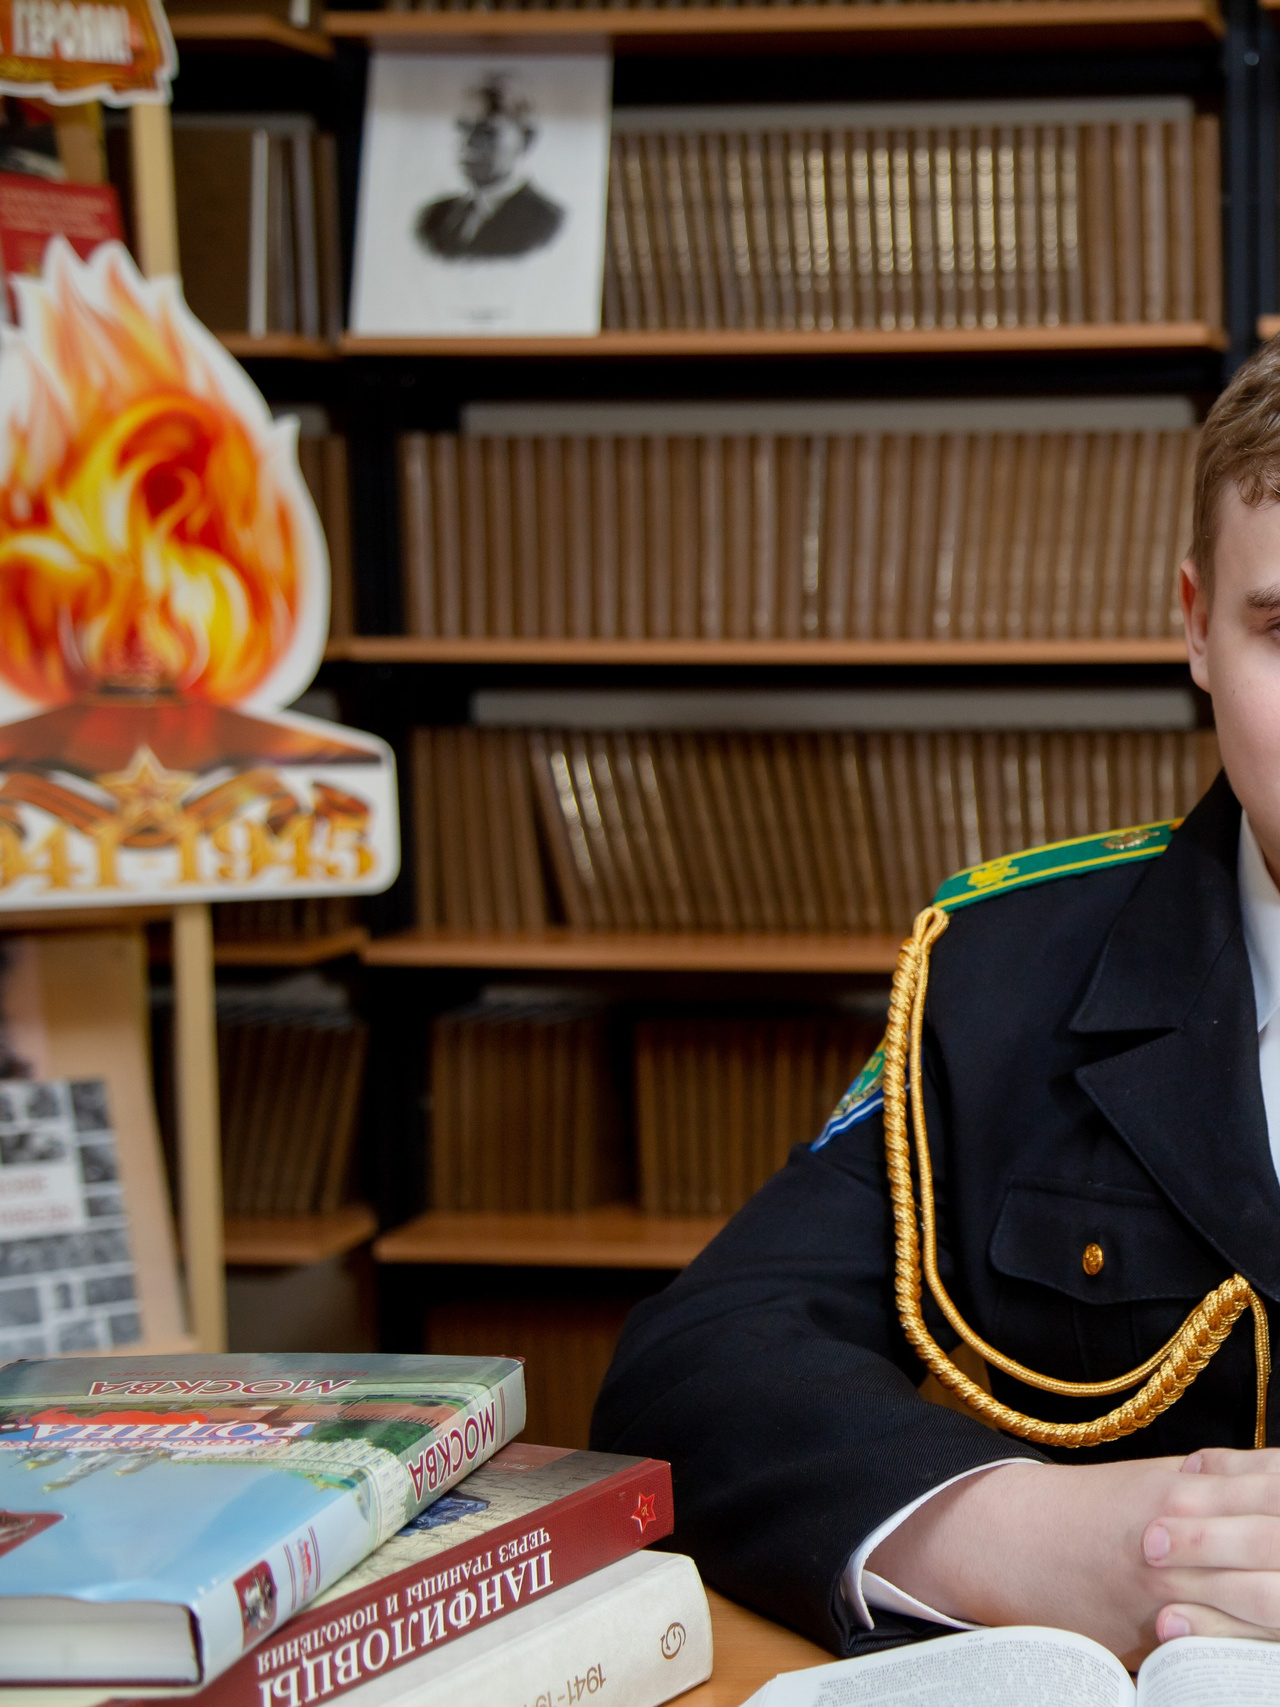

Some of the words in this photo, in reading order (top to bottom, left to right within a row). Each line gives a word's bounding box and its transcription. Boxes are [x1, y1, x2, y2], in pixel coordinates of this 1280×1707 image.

[89, 1379, 356, 1396] МОСКВА
[406, 1399, 495, 1504] МОСКВА
[498, 1527, 551, 1562] ЧЕРЕЗ
[406, 1551, 493, 1599] ГРАНИЦЫ
[258, 1550, 554, 1707] ПАНФИЛОВЦЫ
[385, 1592, 399, 1617] И
[257, 1603, 379, 1675] ПОКОЛЕНИЯ
